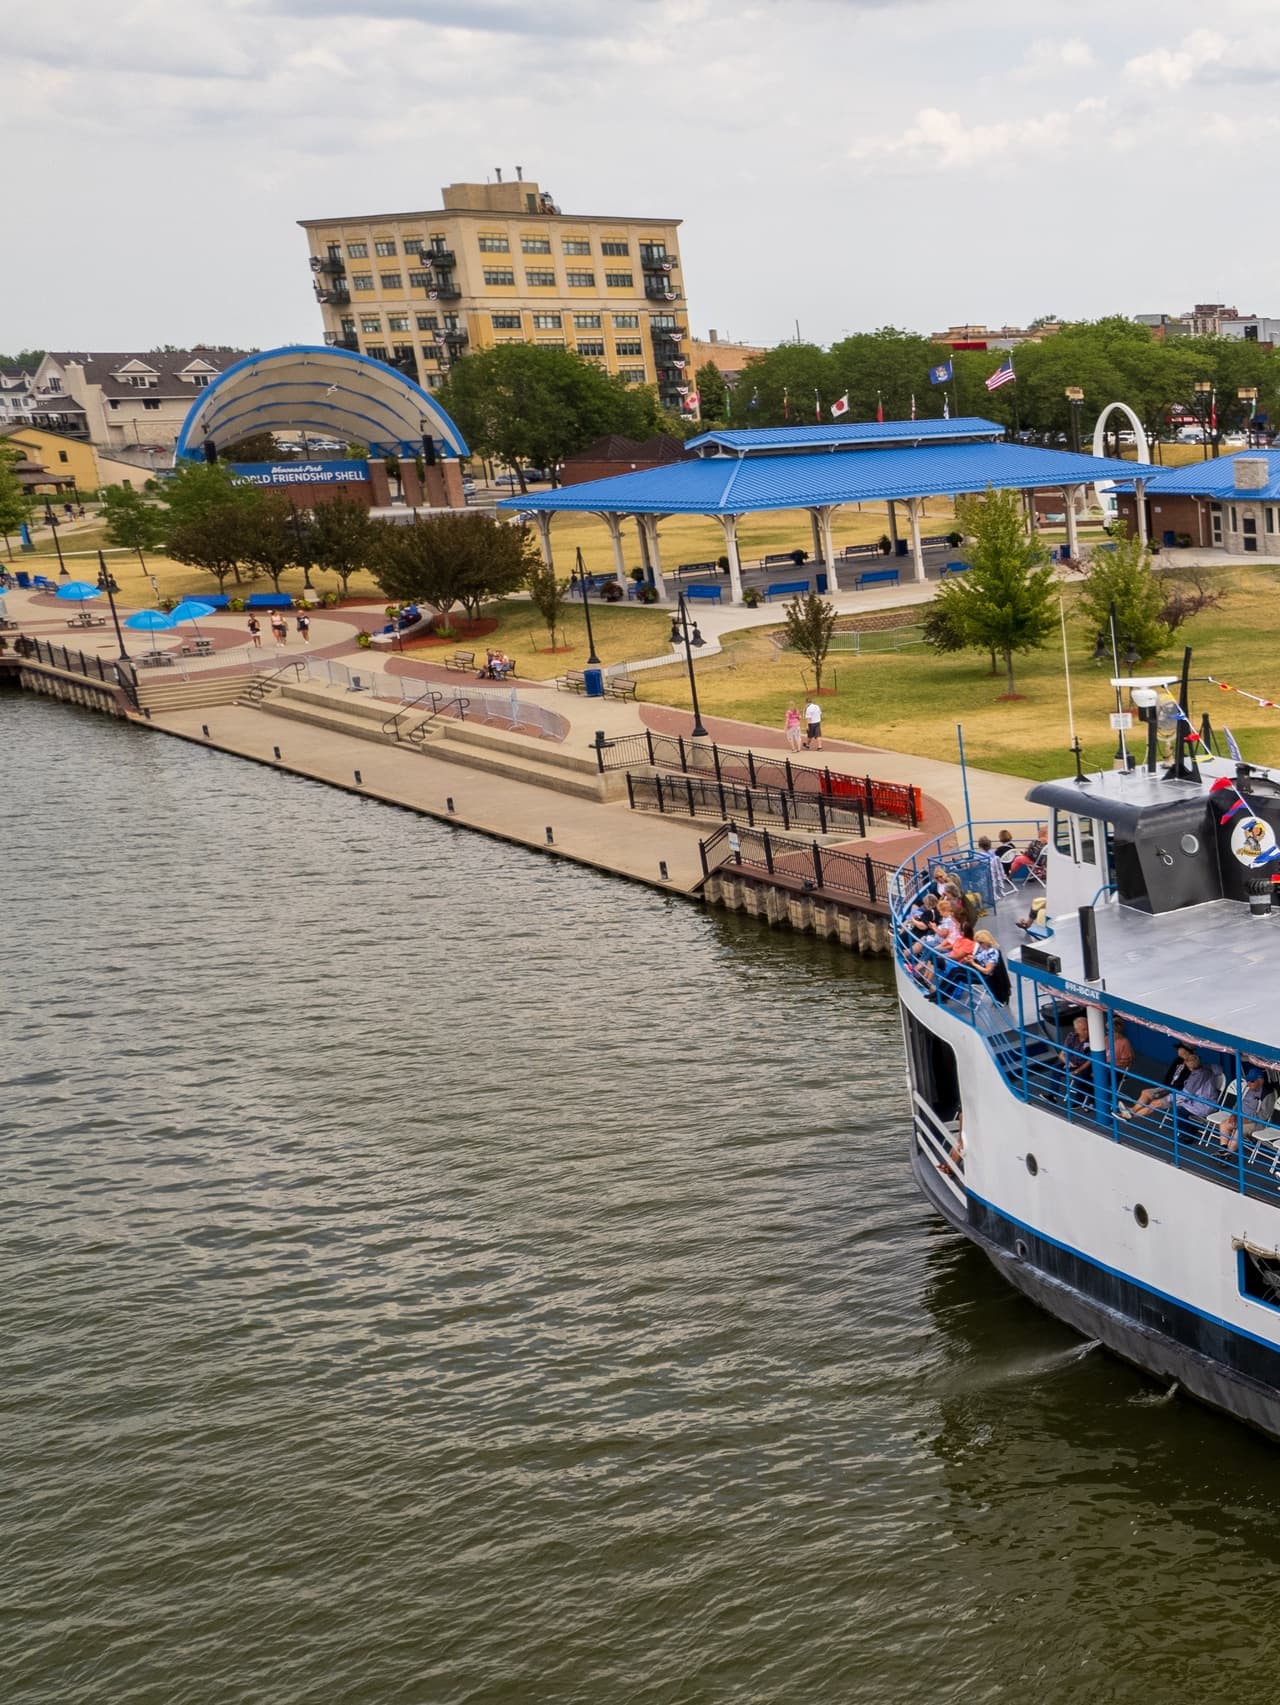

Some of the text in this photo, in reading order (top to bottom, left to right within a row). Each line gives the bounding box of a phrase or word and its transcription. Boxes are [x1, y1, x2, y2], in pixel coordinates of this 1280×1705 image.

[231, 471, 365, 486] WORLD FRIENDSHIP SHELL
